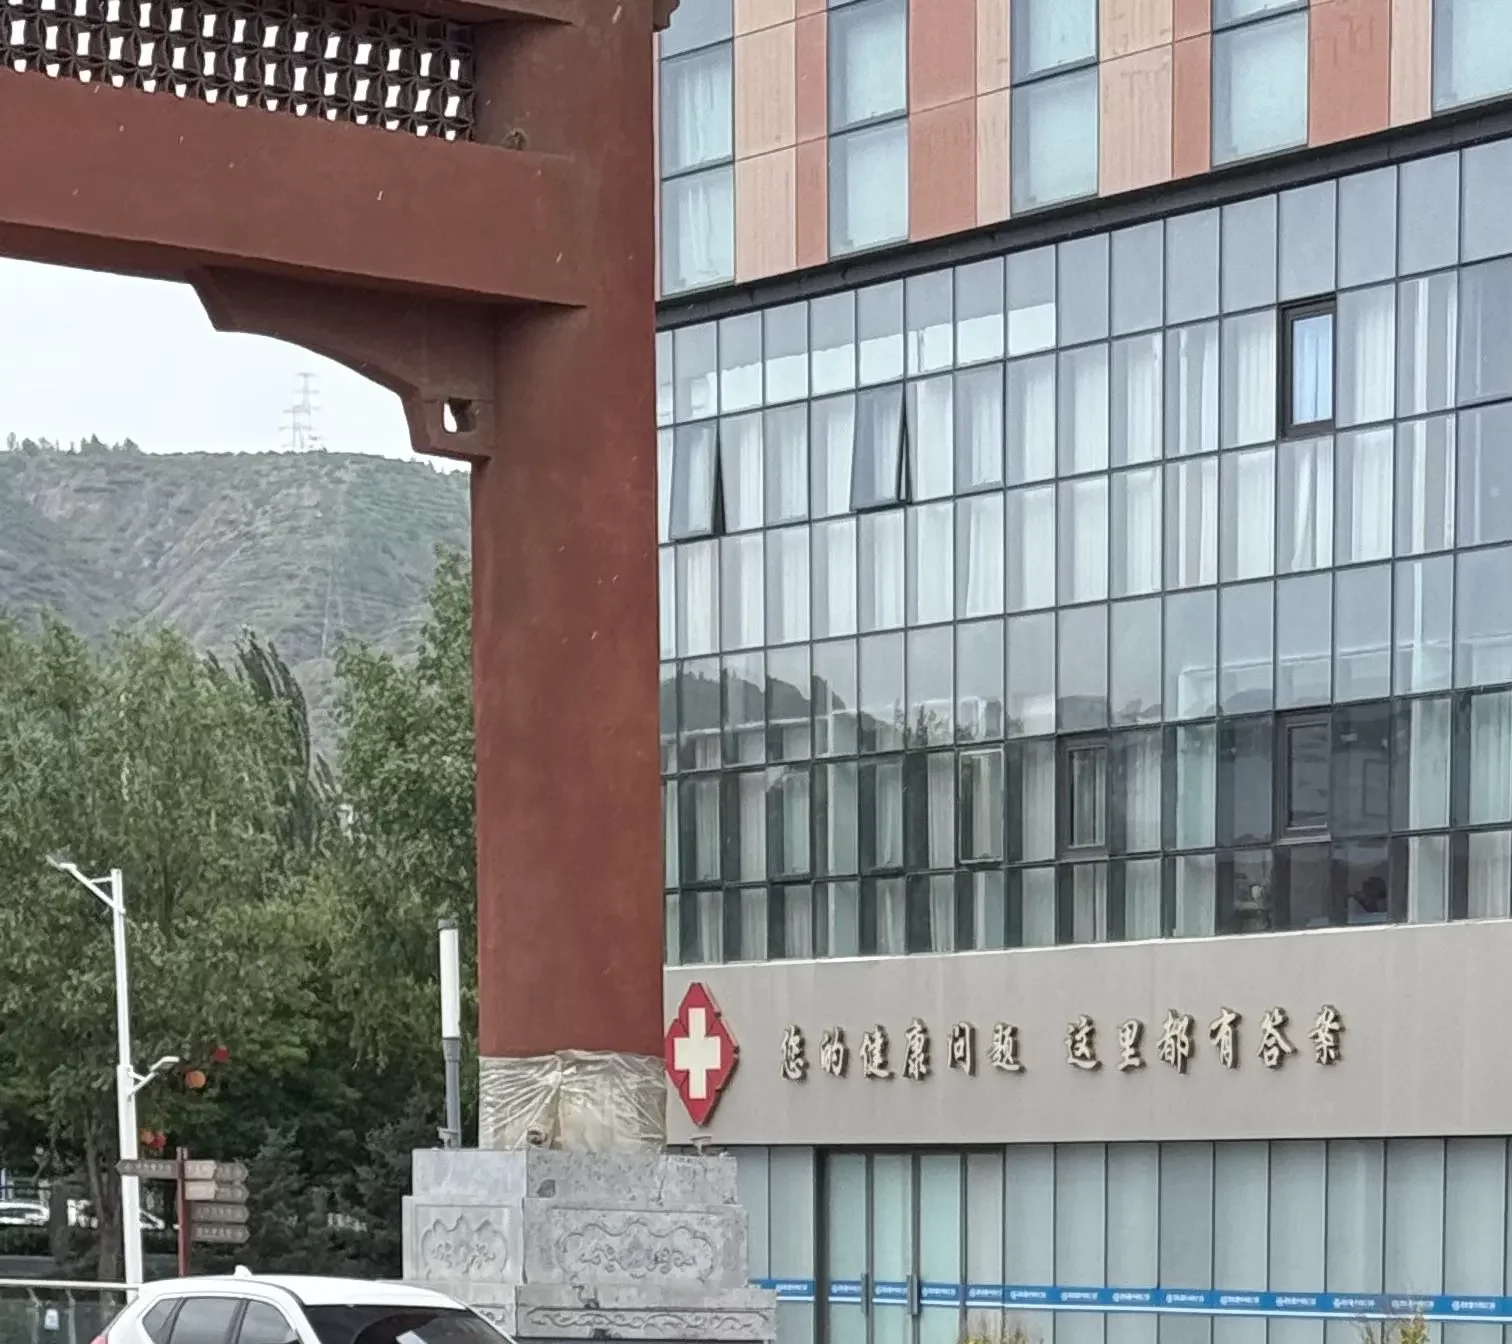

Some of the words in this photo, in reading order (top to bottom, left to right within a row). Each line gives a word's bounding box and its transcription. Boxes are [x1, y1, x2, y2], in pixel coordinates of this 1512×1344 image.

[779, 1018, 1026, 1082] 您的健康问题
[1065, 1005, 1346, 1075] 这里都有答案
